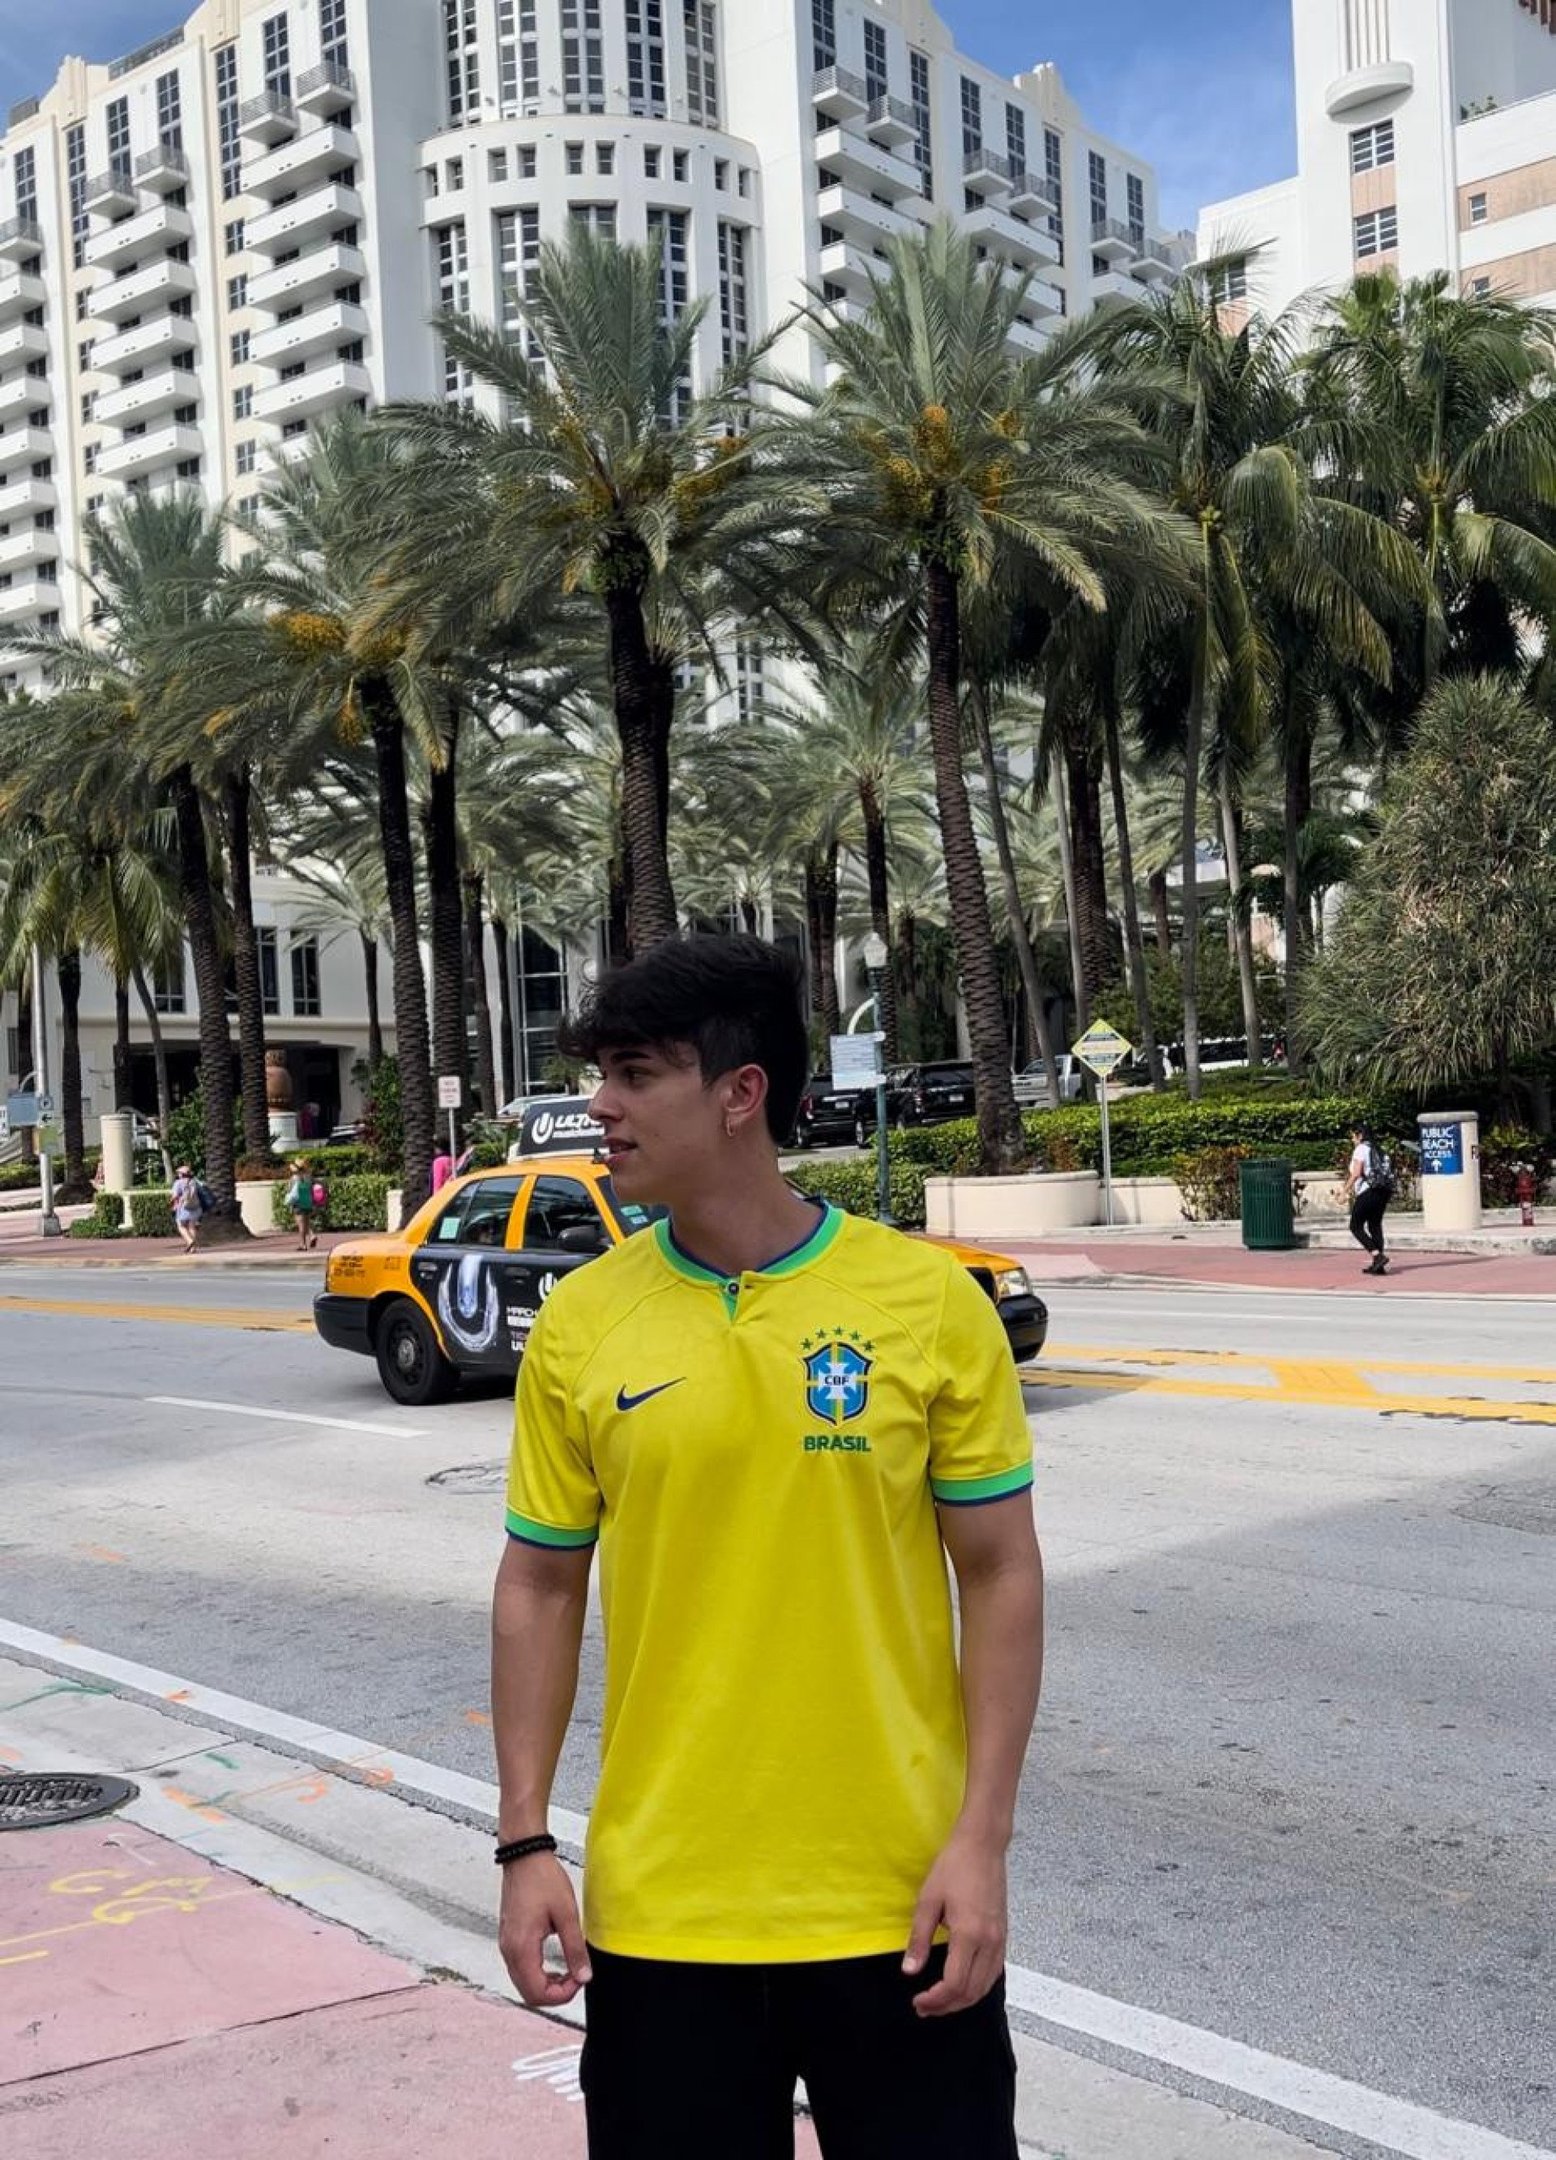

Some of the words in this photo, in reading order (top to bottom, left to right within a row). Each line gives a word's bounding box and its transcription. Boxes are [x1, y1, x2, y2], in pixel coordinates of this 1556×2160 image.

[1422, 1125, 1455, 1138] PUBLIC
[1422, 1138, 1454, 1150] BEACH
[824, 1375, 850, 1386] CBF
[804, 1435, 872, 1452] BRASIL
